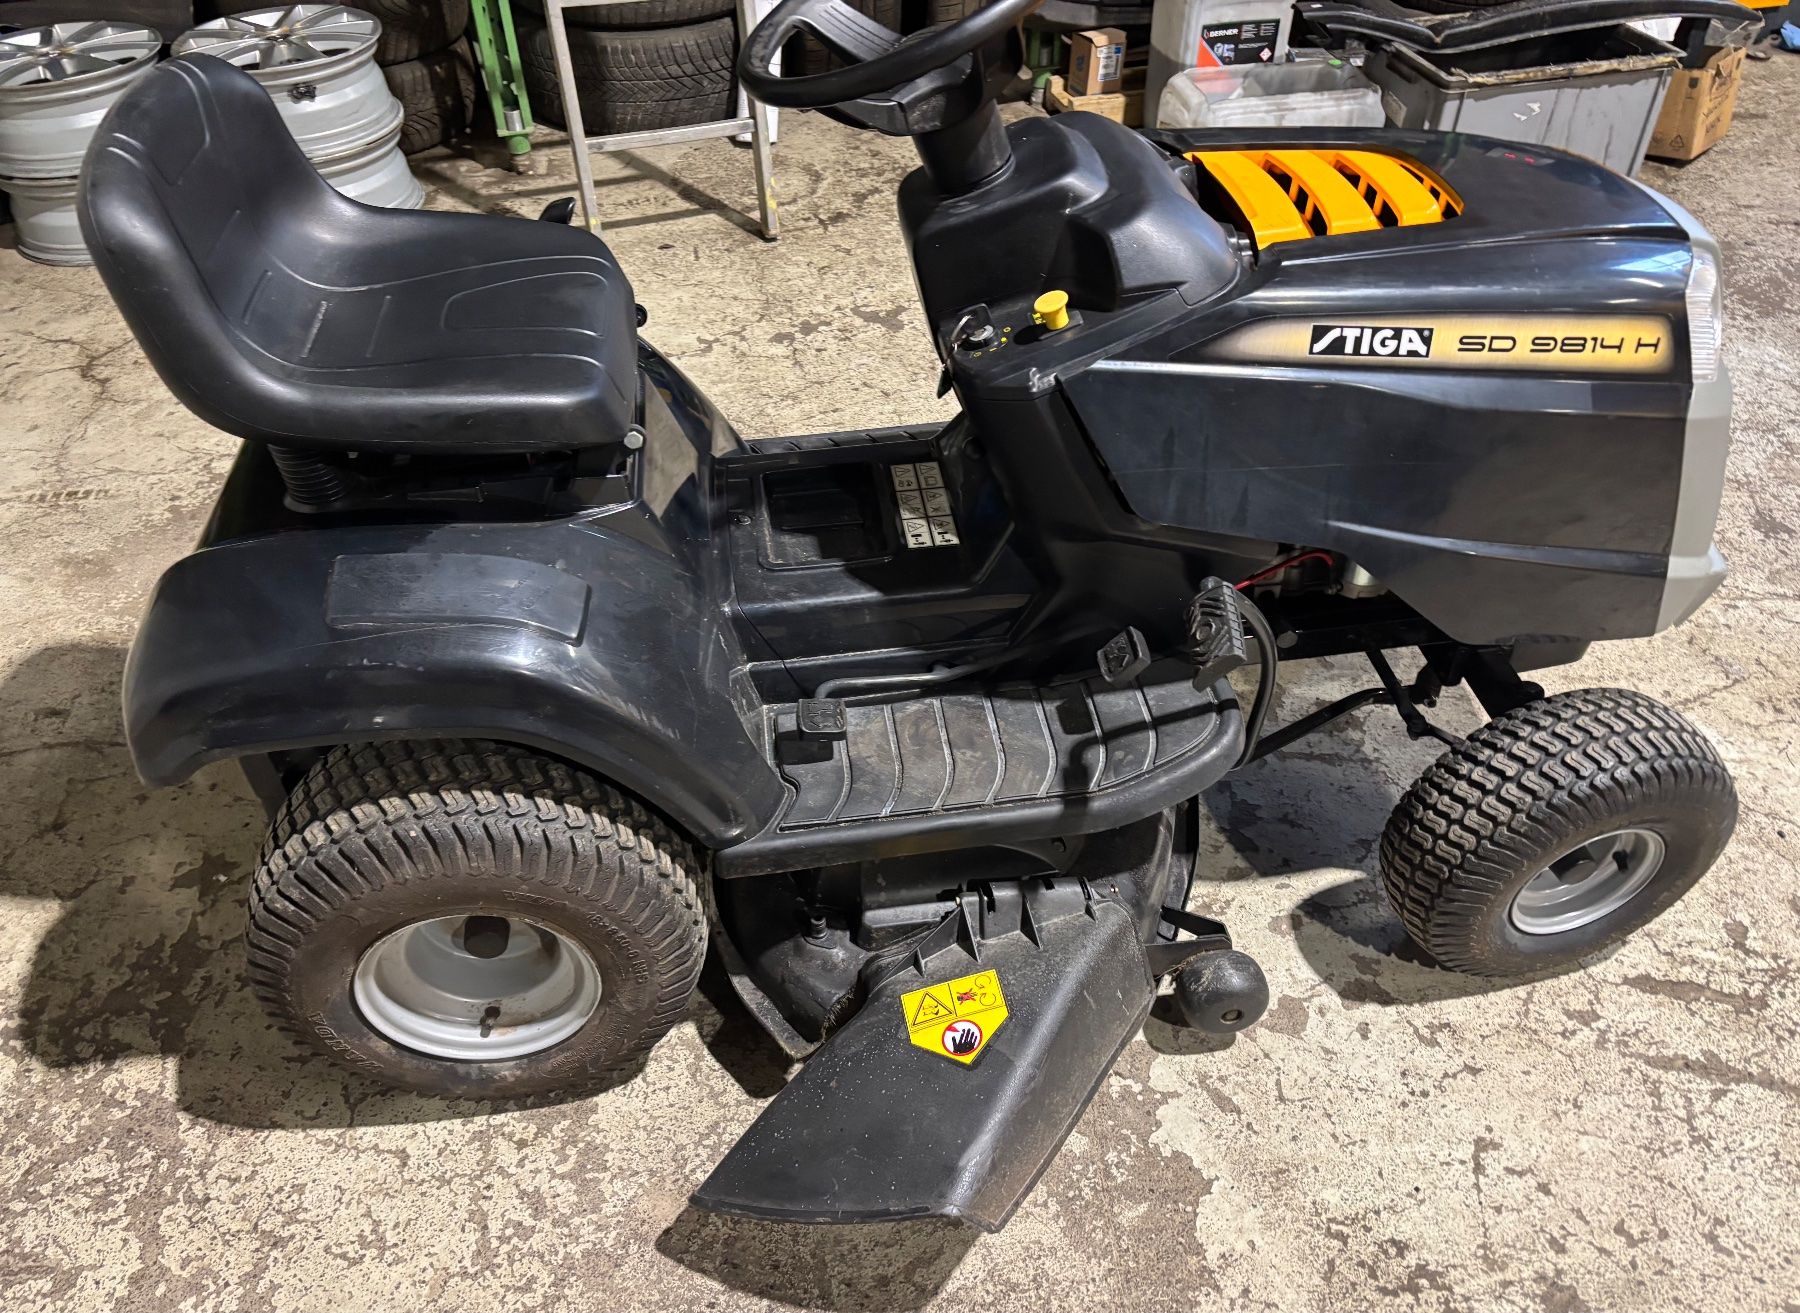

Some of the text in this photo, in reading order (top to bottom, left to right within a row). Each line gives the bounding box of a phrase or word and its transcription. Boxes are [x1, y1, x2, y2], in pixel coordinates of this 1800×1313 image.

[1209, 28, 1239, 38] BERNER
[1457, 335, 1661, 354] SD 9814 H
